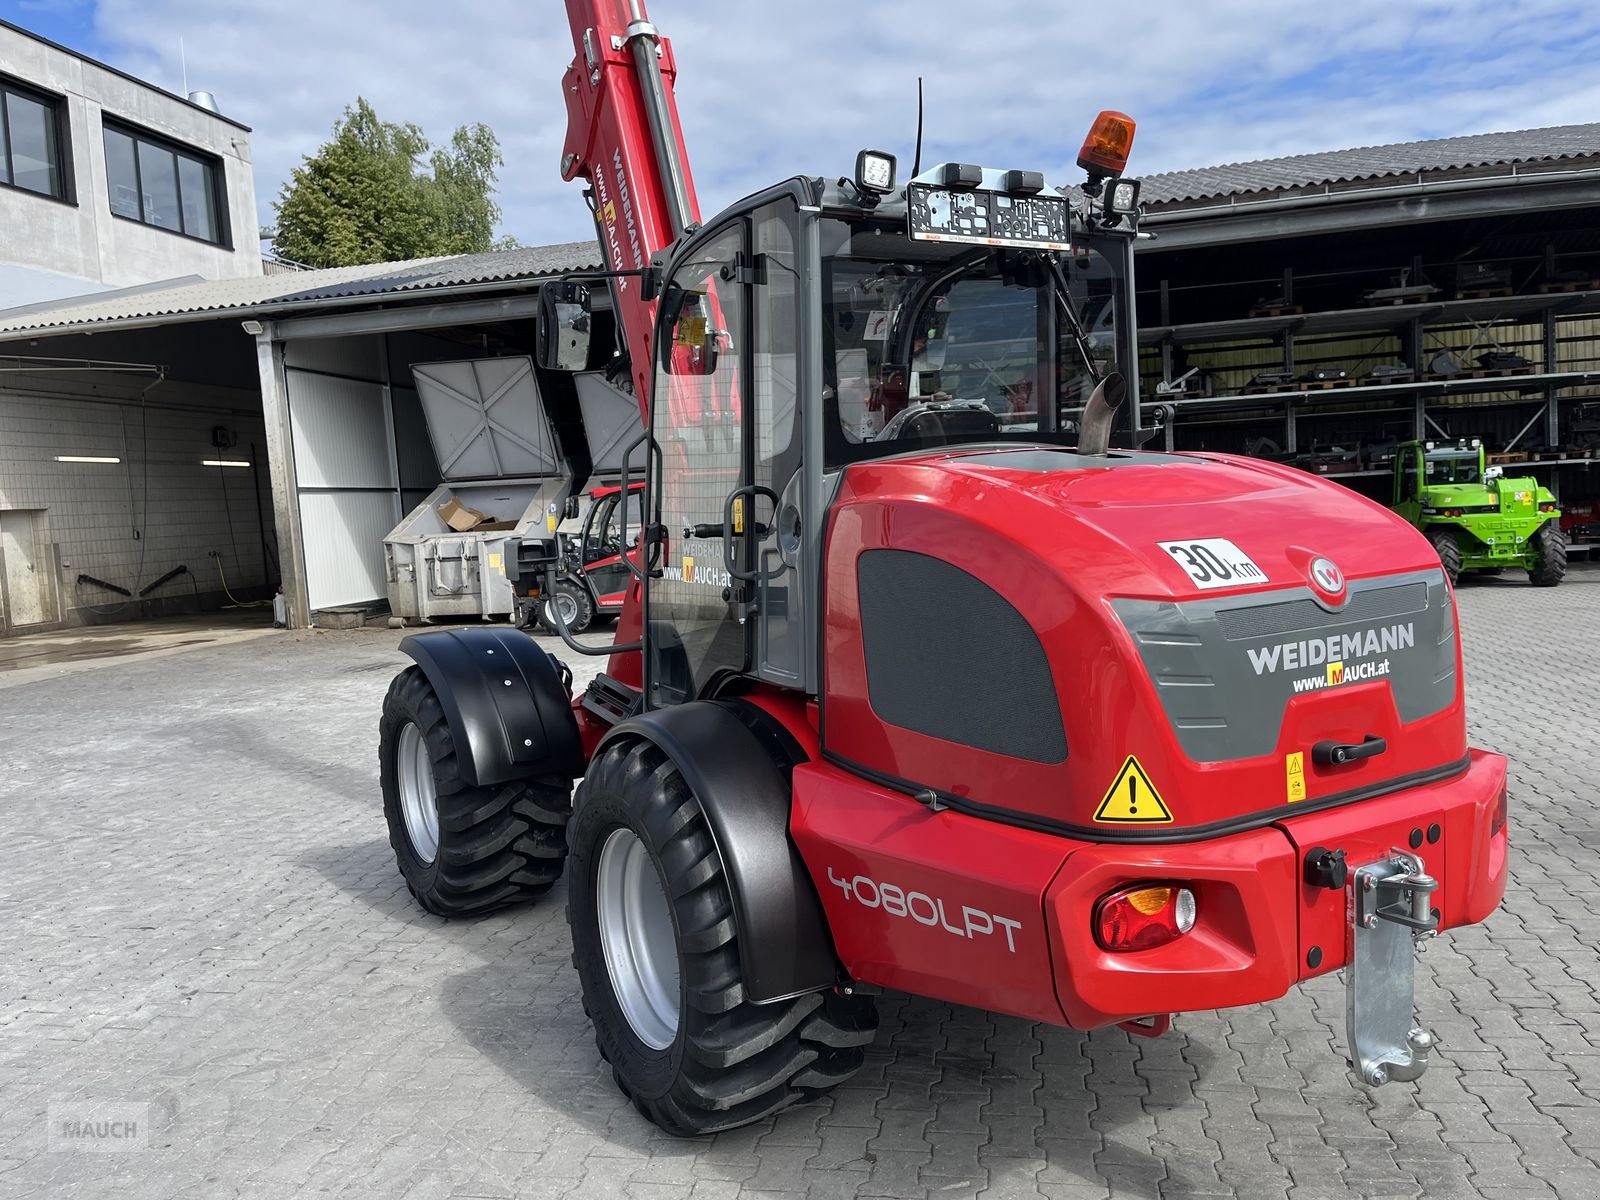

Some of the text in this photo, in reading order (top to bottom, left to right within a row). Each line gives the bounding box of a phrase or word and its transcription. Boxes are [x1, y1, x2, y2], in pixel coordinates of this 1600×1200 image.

[595, 162, 628, 292] www.MAUCHat
[612, 146, 644, 271] WEIDEMANN
[662, 565, 732, 587] www.MAUCH.at
[1169, 544, 1261, 582] 30 km
[1247, 622, 1415, 676] WEIDEMANN
[1293, 658, 1390, 692] www.MAUCH.at
[827, 866, 1023, 953] 4080LPT
